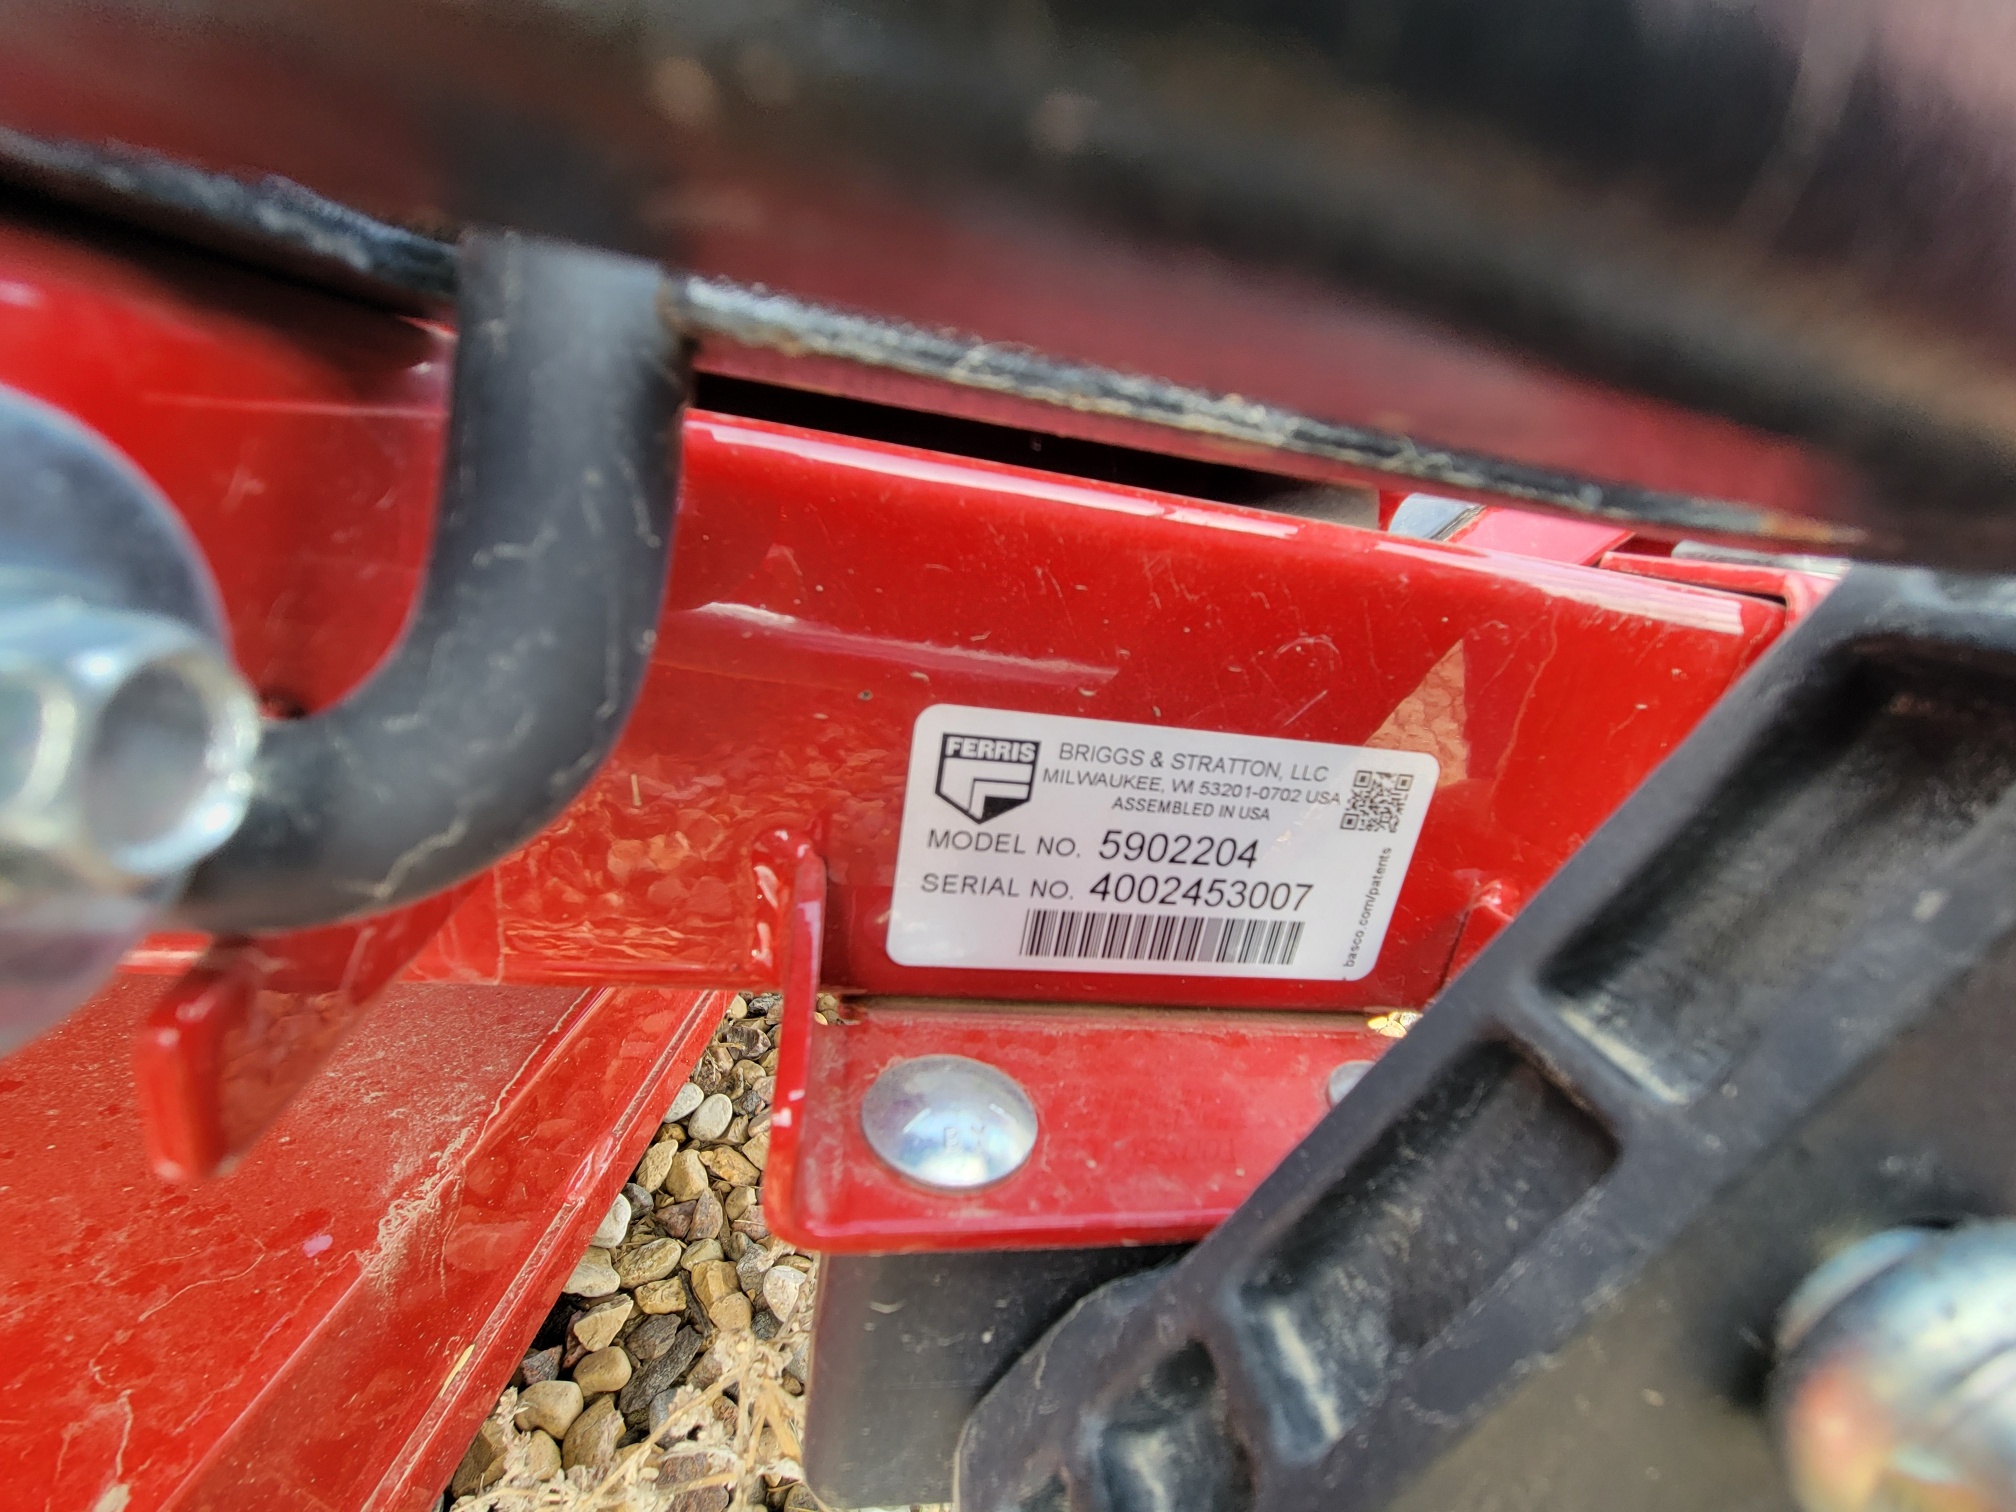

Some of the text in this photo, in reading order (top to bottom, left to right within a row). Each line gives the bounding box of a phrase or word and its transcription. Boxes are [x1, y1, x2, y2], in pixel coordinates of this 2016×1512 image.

[944, 735, 1037, 763] FERRIS
[1059, 742, 1330, 783] BRIGGS & STRATTON, LLC
[1042, 767, 1342, 806] MILWAUKEE, WI 53201-0702 USA
[1111, 796, 1271, 822] ASSEMBLED IN USA
[927, 828, 1259, 869] MODEL NO. 5902204
[920, 872, 1314, 912] SERIAL NO. 4002453007
[1343, 847, 1392, 968] basco.com/patents
